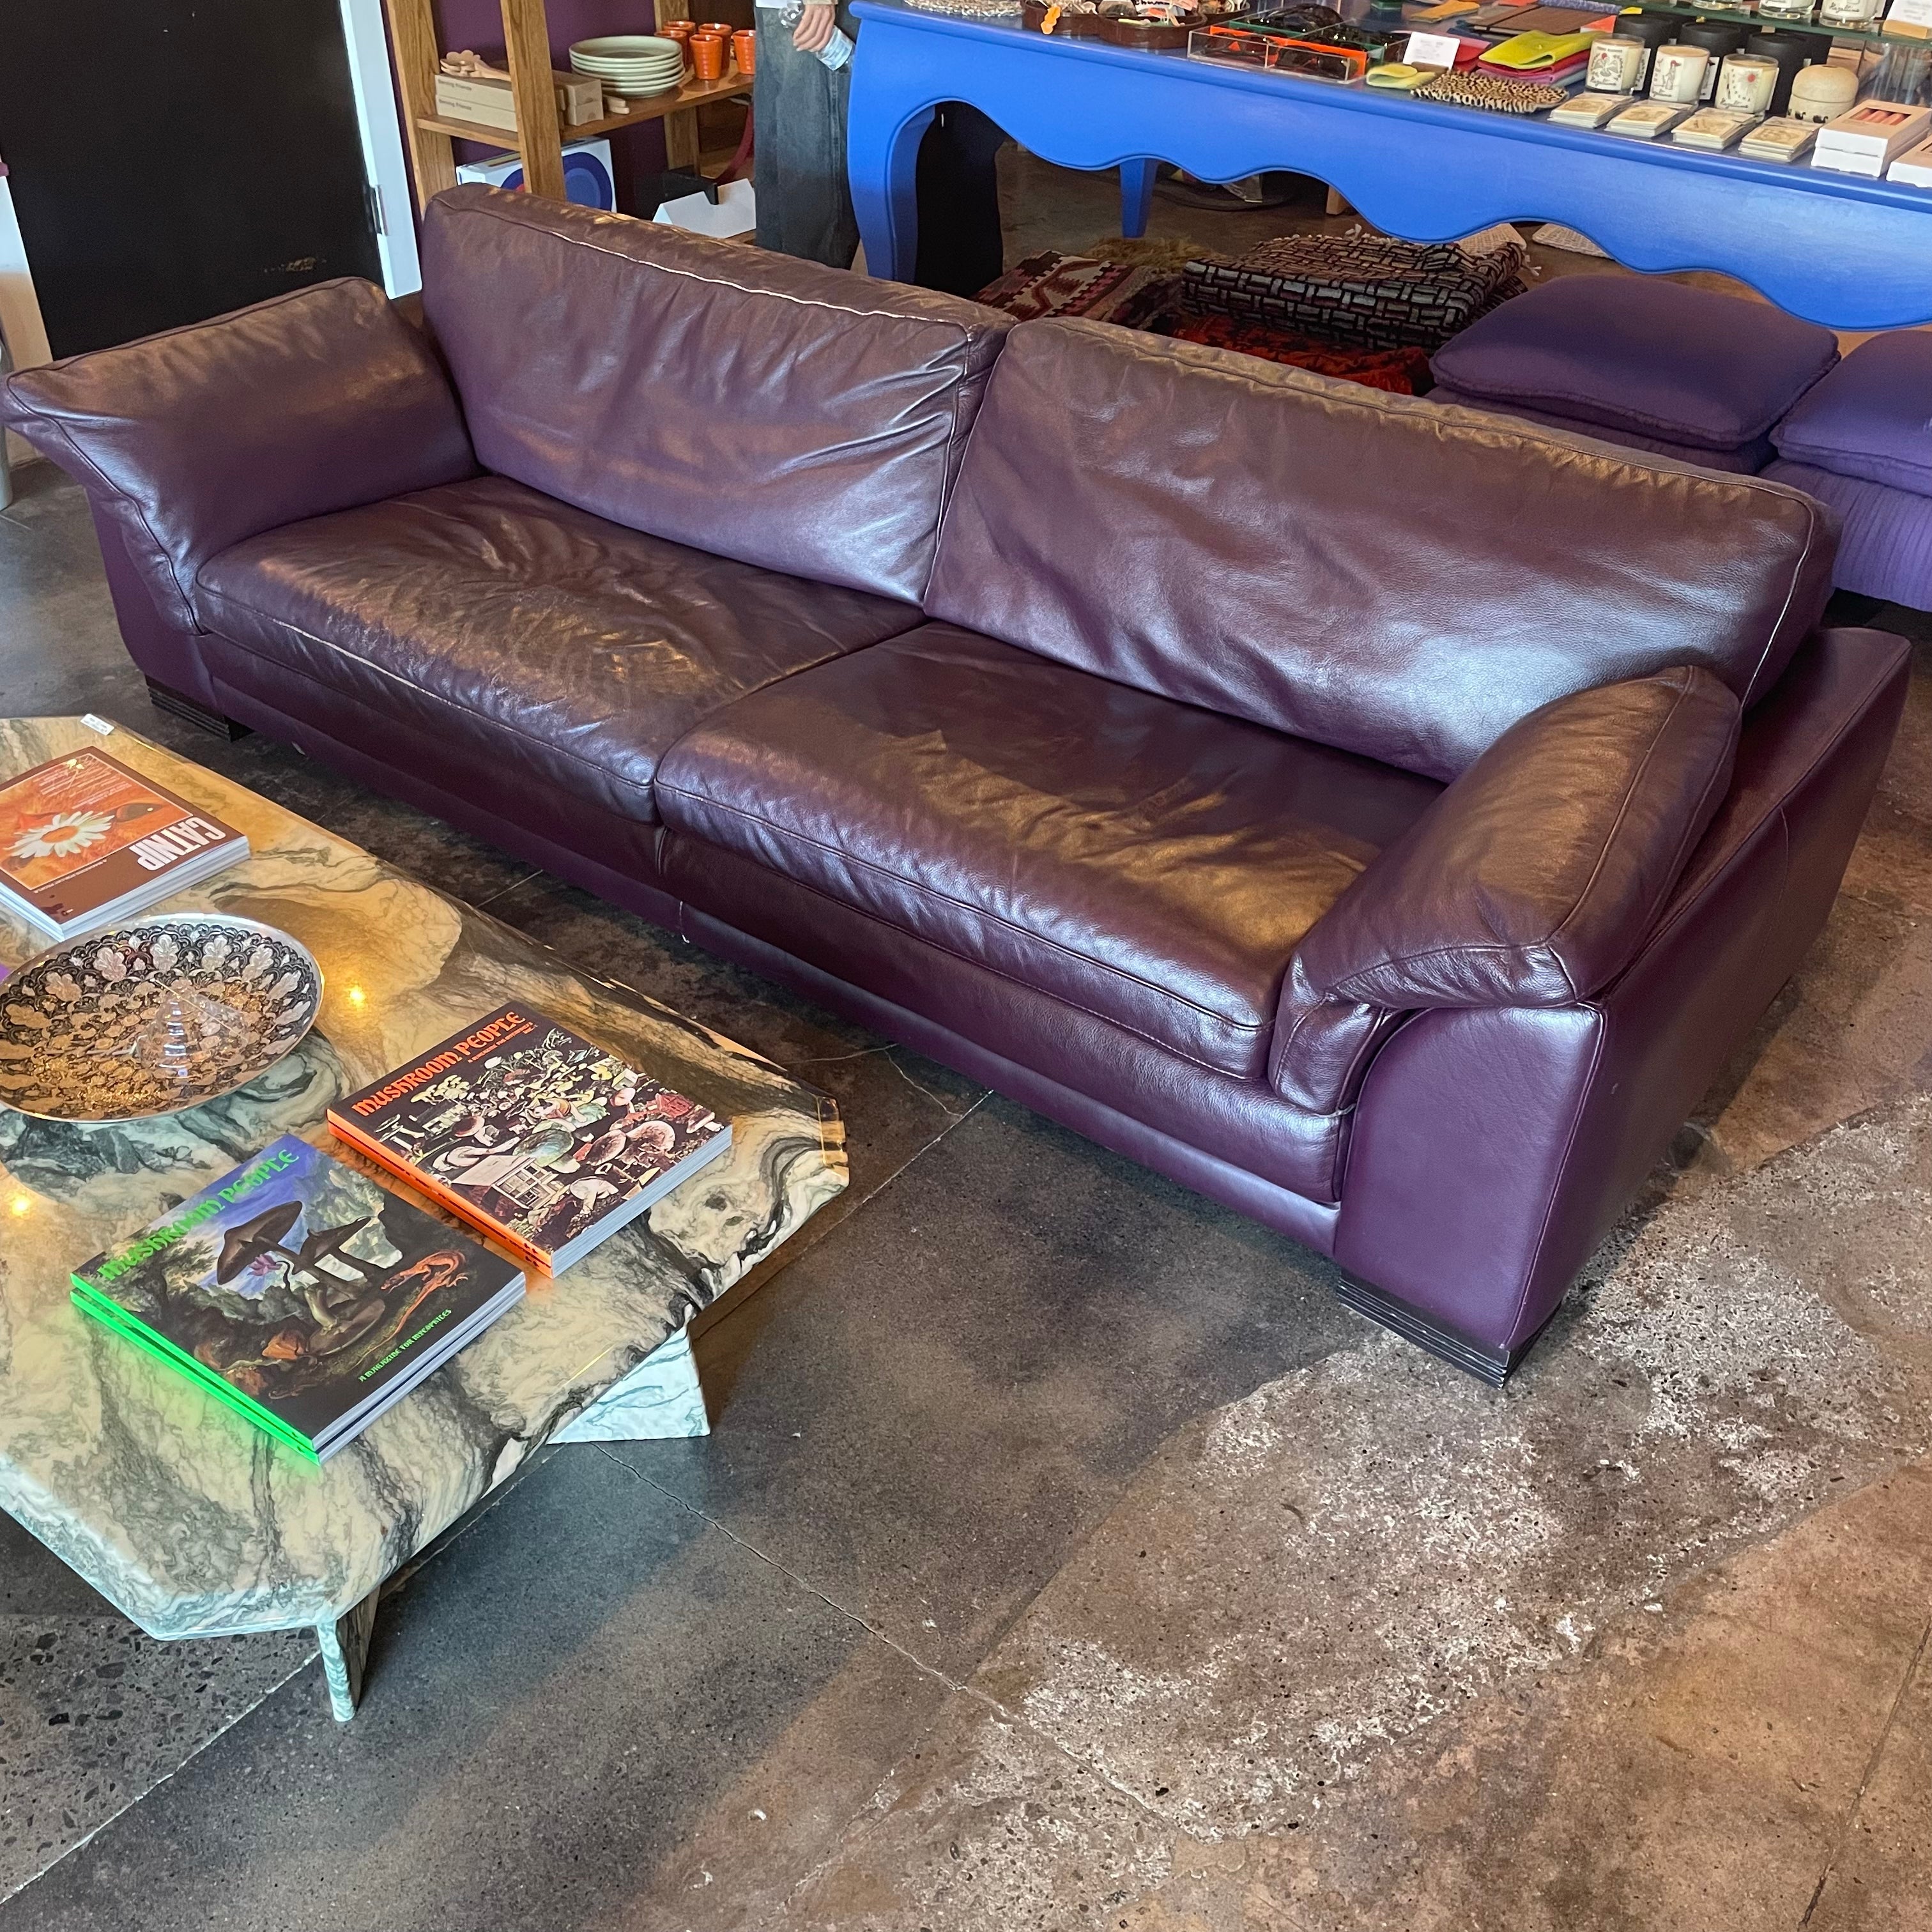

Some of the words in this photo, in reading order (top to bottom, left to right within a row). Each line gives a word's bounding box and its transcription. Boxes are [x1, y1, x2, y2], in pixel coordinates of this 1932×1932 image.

[128, 816, 226, 871] CATNIP
[351, 1051, 463, 1117] MUSHROOM
[453, 1011, 526, 1056] PEOPLE
[96, 1198, 225, 1281] MUSHROOM
[217, 1149, 300, 1203] PEOPLE
[364, 1348, 402, 1377] MAGAZINE
[399, 1338, 415, 1350] FOR
